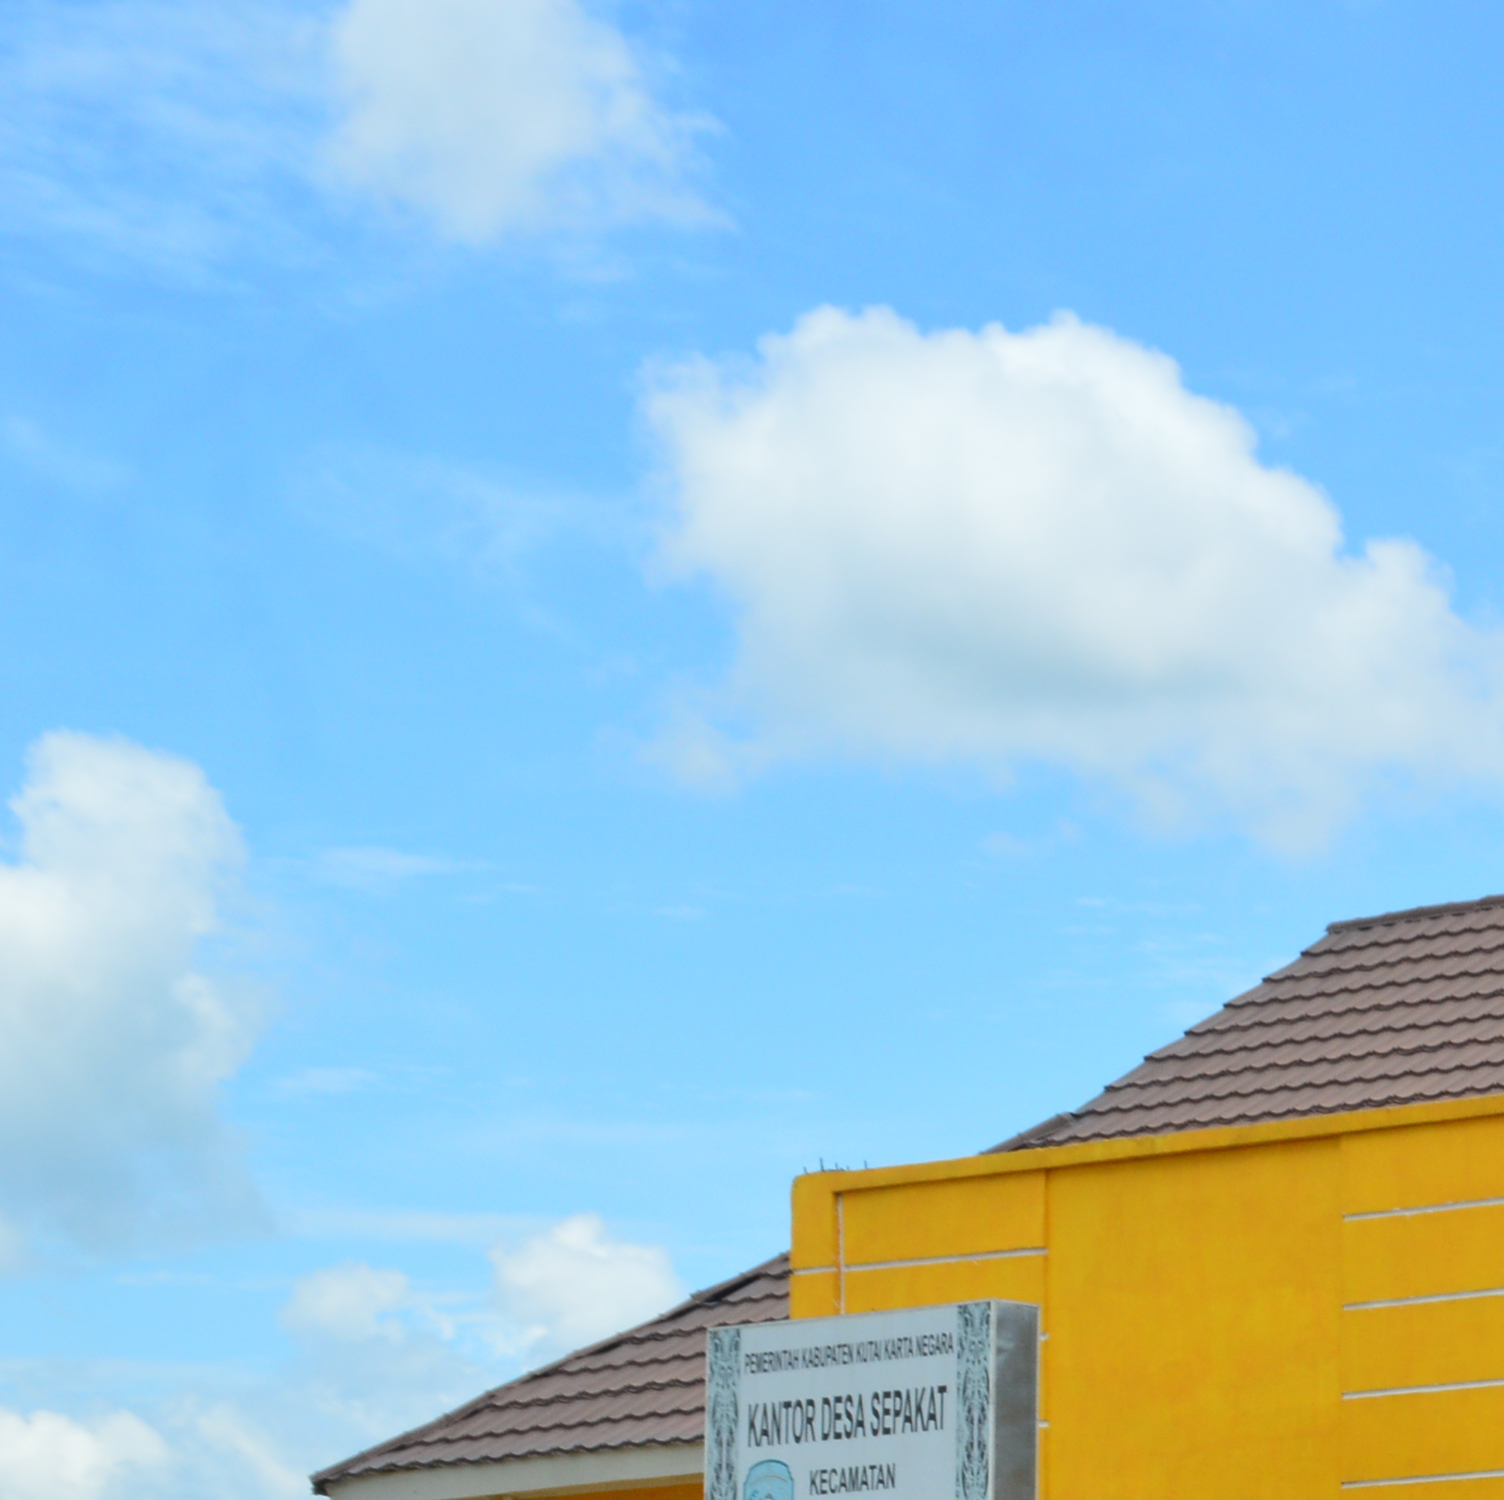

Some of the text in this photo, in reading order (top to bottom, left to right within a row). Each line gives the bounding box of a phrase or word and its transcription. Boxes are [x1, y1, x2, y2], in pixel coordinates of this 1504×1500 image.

[744, 1332, 955, 1375] PEMERINTAH KABUPATEN KUTAI KARTA NEGARA
[748, 1385, 947, 1448] KANTOR DESA SEPAKAT
[809, 1463, 896, 1496] KECAMATAN
